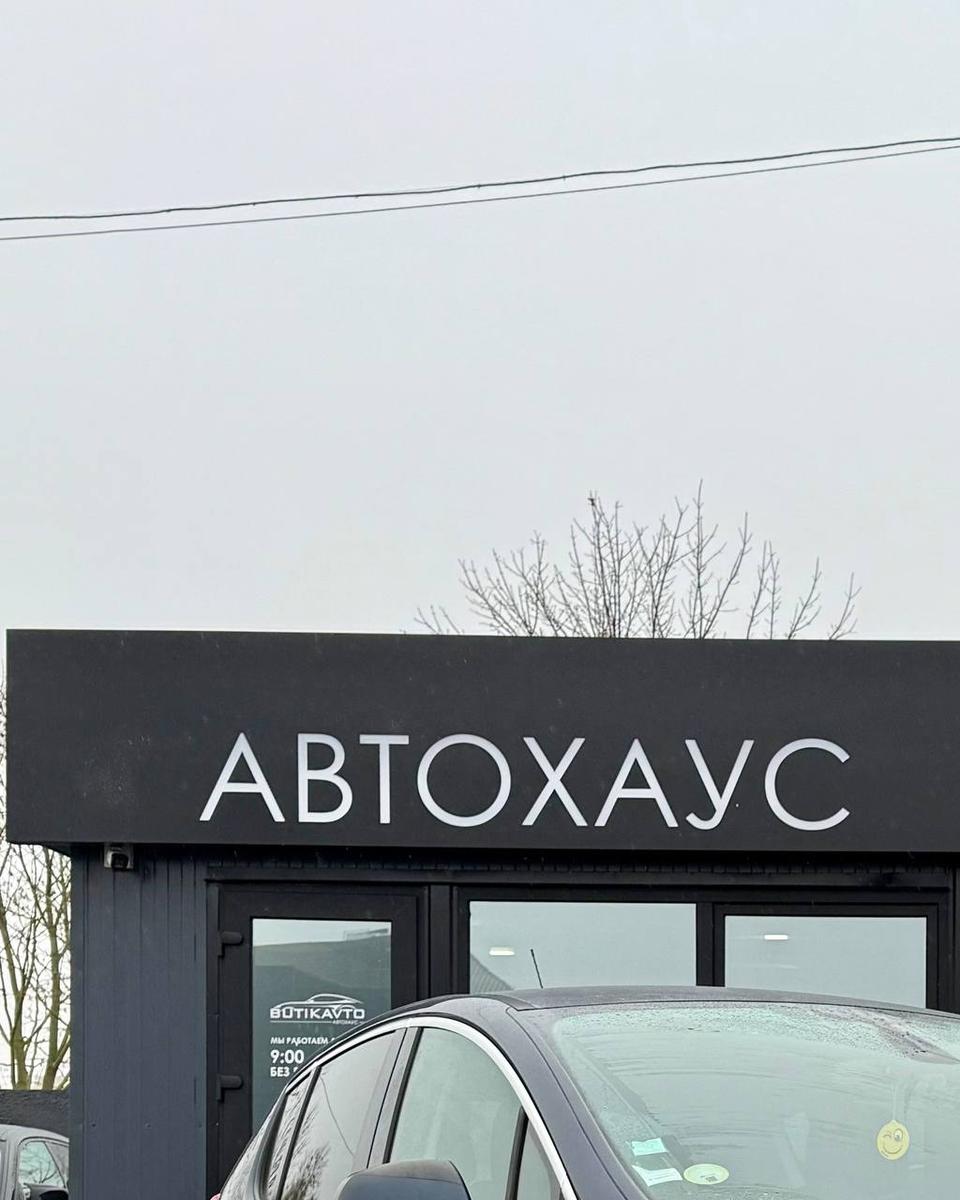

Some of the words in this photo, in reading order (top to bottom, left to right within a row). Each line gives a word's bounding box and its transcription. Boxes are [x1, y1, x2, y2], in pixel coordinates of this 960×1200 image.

[198, 732, 852, 832] АВТОХАУС
[270, 1007, 366, 1020] BUTIKAVTO
[270, 1037, 285, 1045] МЫ
[286, 1037, 329, 1046] РАБОТАЕМ
[270, 1050, 305, 1064] 9:00
[270, 1066, 290, 1077] БЕЗ
